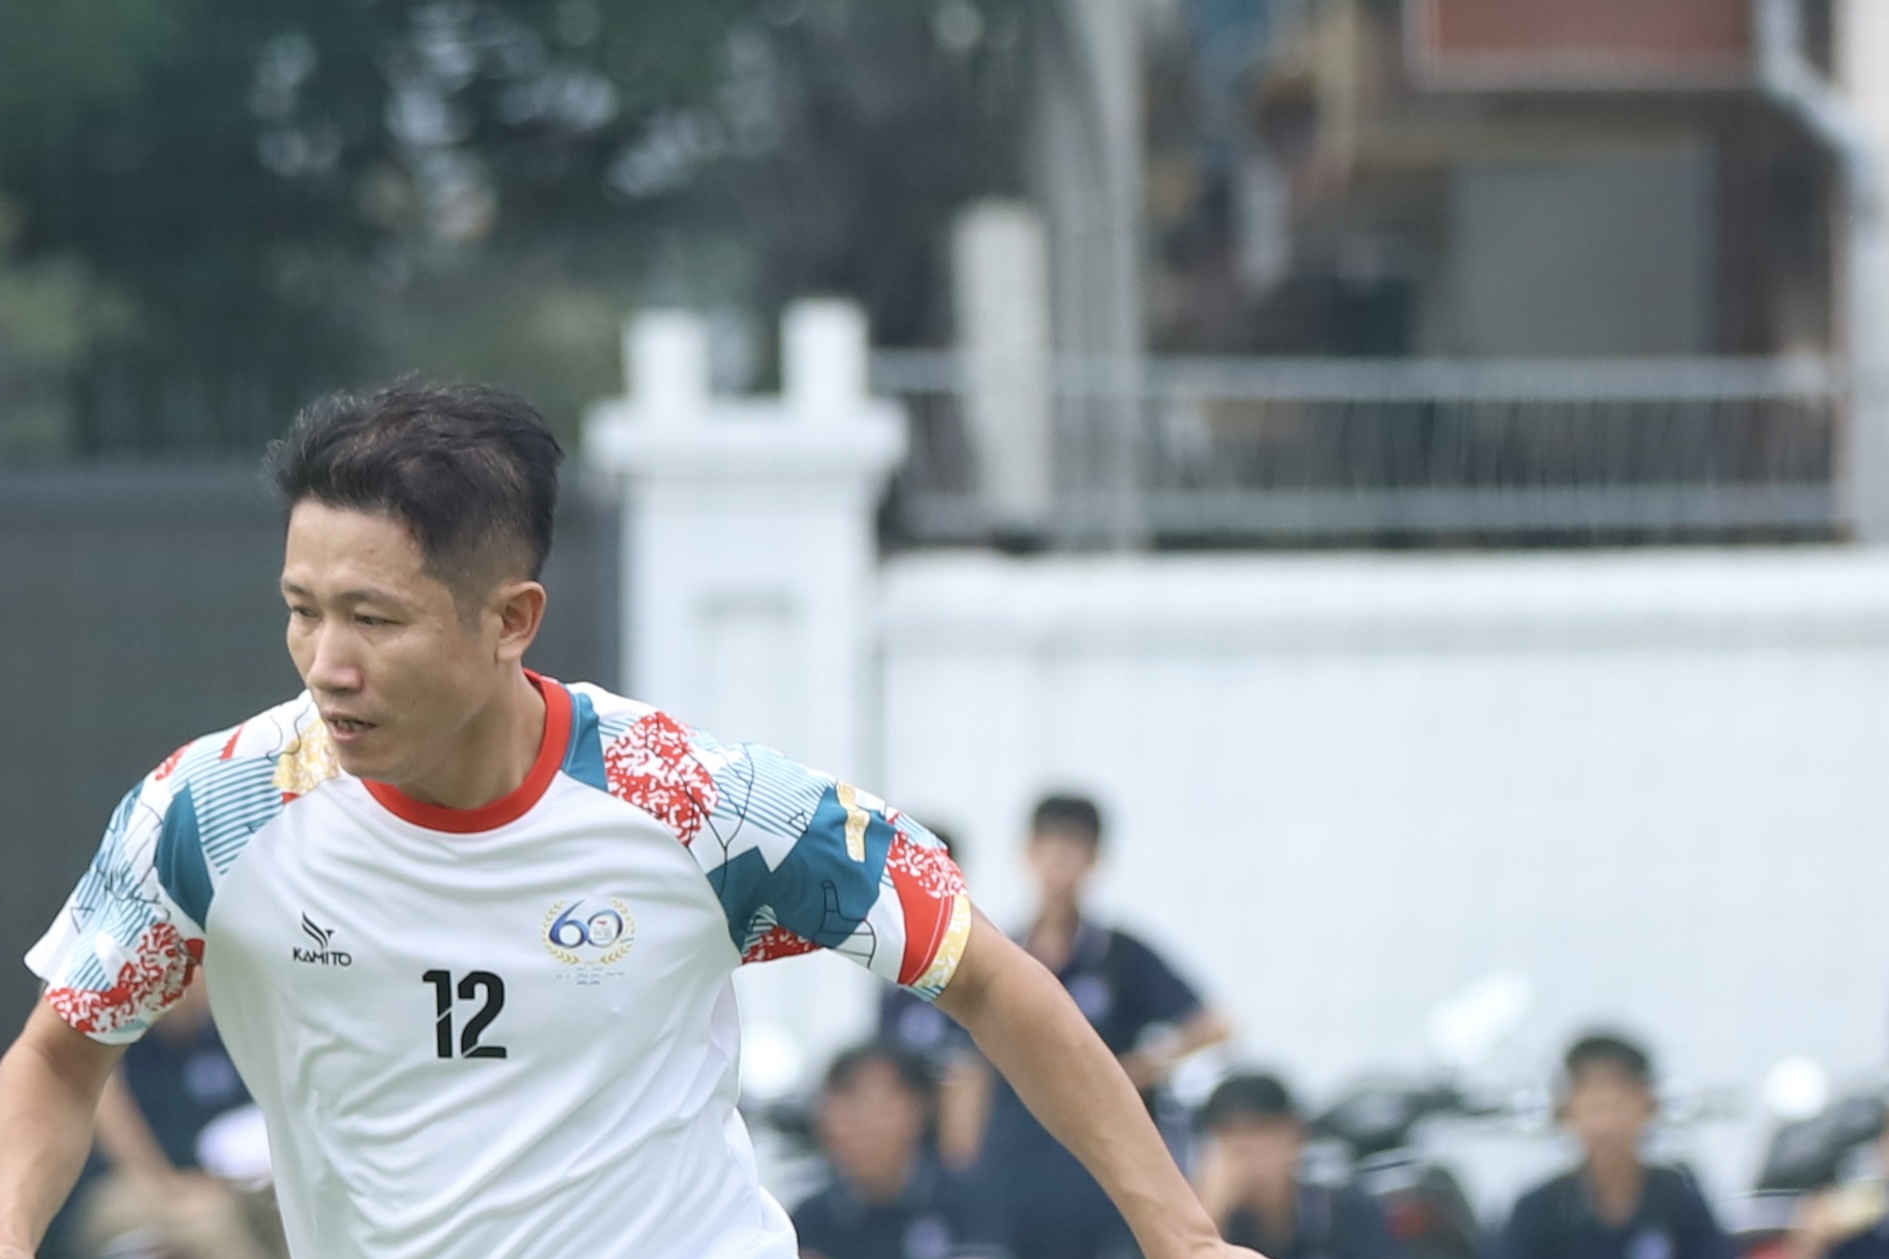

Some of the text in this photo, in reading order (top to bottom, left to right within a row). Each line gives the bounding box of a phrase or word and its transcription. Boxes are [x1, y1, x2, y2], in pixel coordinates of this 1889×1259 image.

[548, 899, 623, 949] 60
[292, 947, 352, 967] KAMITO
[422, 969, 508, 1060] 12
